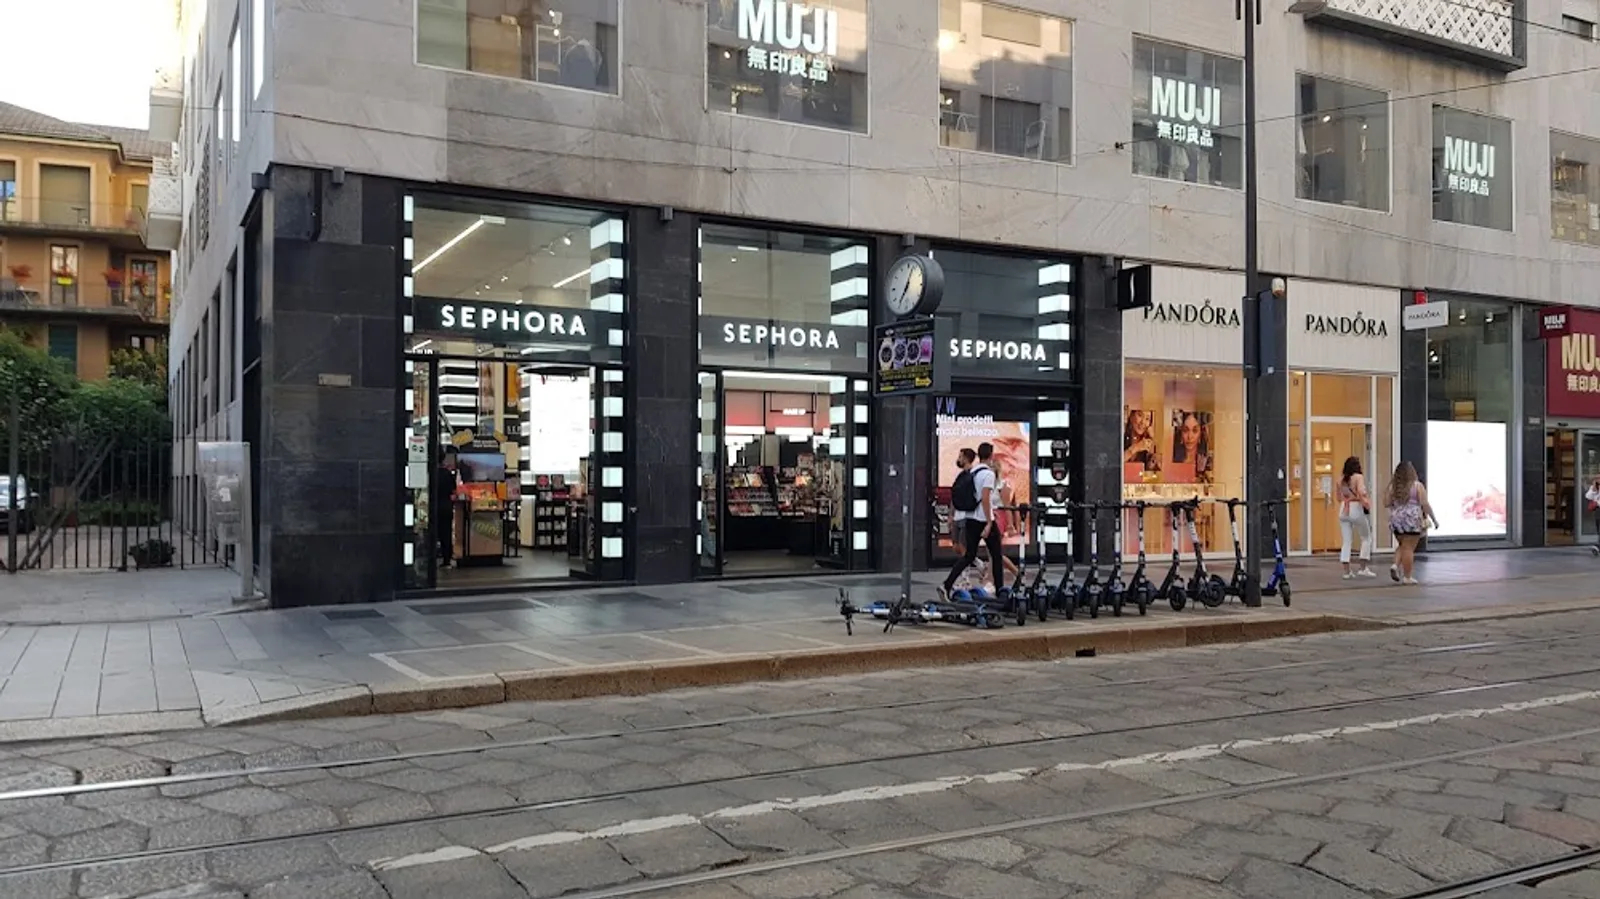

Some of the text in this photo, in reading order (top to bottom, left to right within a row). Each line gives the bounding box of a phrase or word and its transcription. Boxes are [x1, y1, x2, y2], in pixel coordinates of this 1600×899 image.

[738, 0, 837, 56] MUJI
[747, 45, 828, 82] 無印良品
[1152, 75, 1220, 126] MUJI
[1157, 120, 1213, 147] 無印良品
[1444, 135, 1495, 178] MUJI
[441, 304, 586, 336] SEPHORA
[723, 322, 840, 349] SEPHORA
[950, 338, 1046, 361] SEPHORA
